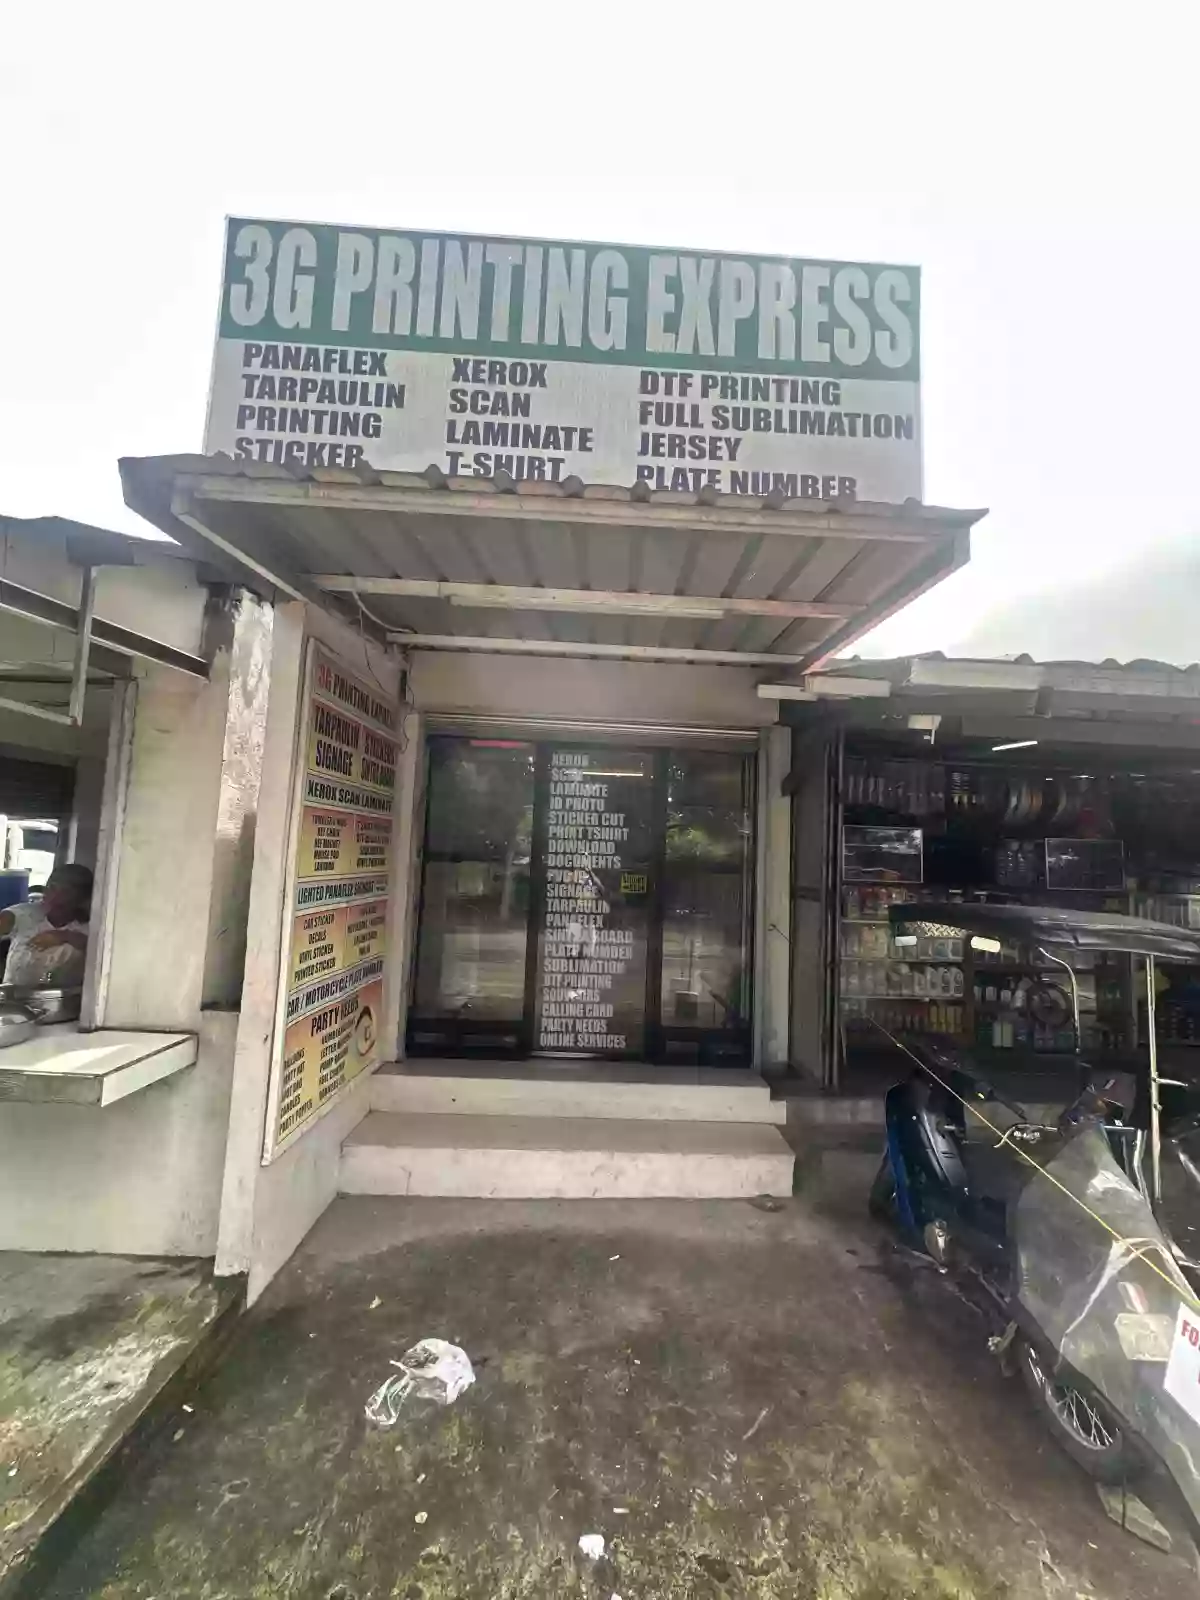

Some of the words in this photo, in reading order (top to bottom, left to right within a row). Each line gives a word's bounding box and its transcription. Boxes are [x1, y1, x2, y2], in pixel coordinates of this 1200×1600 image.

[229, 224, 317, 329] 3G
[331, 232, 629, 350] PRINTING
[645, 254, 913, 369] EXPRESS
[242, 342, 388, 377] PANAFLEX
[452, 357, 548, 388] XEROX
[241, 374, 406, 409] TARPAULIN
[639, 370, 693, 398] DTF
[700, 372, 841, 405] PRINTING
[449, 389, 531, 418] SCAN
[236, 405, 382, 439] PRINTING
[446, 419, 593, 452] LAMINATE
[639, 401, 704, 429] FULL
[711, 404, 914, 440] SUBLIMATION
[235, 437, 365, 469] STICKER
[637, 432, 742, 461] JERSEY
[446, 451, 565, 482] T-SHIRT
[636, 464, 721, 493] PLATE
[730, 470, 857, 498] NUMBER
[315, 705, 360, 749] TARPAULIN
[315, 740, 353, 776] SIGNAGE
[307, 779, 337, 801] XEROX
[338, 787, 360, 806] SCAN
[548, 825, 586, 839] PRINT
[549, 811, 598, 825] STICKER
[601, 813, 625, 827] CUT
[547, 854, 621, 869] DOCUMENTS
[548, 839, 615, 854] DOWNLOAD
[298, 887, 323, 905] LIGHTED
[546, 898, 610, 914] TARPAULIN
[546, 913, 604, 928] PANAFLEX
[543, 958, 626, 974] SUBLIMATION
[565, 974, 612, 989] PRINTING
[304, 975, 348, 1006] MOTORCYCLE
[311, 1004, 340, 1037] PARTY
[541, 1018, 574, 1032] PARTY
[576, 1018, 607, 1033] NEEDS
[542, 1003, 584, 1017] CALLING
[585, 1004, 614, 1017] CARD
[540, 1033, 575, 1047] ONLINE
[577, 1034, 626, 1048] SERVICES
[1181, 1319, 1200, 1352] FO
